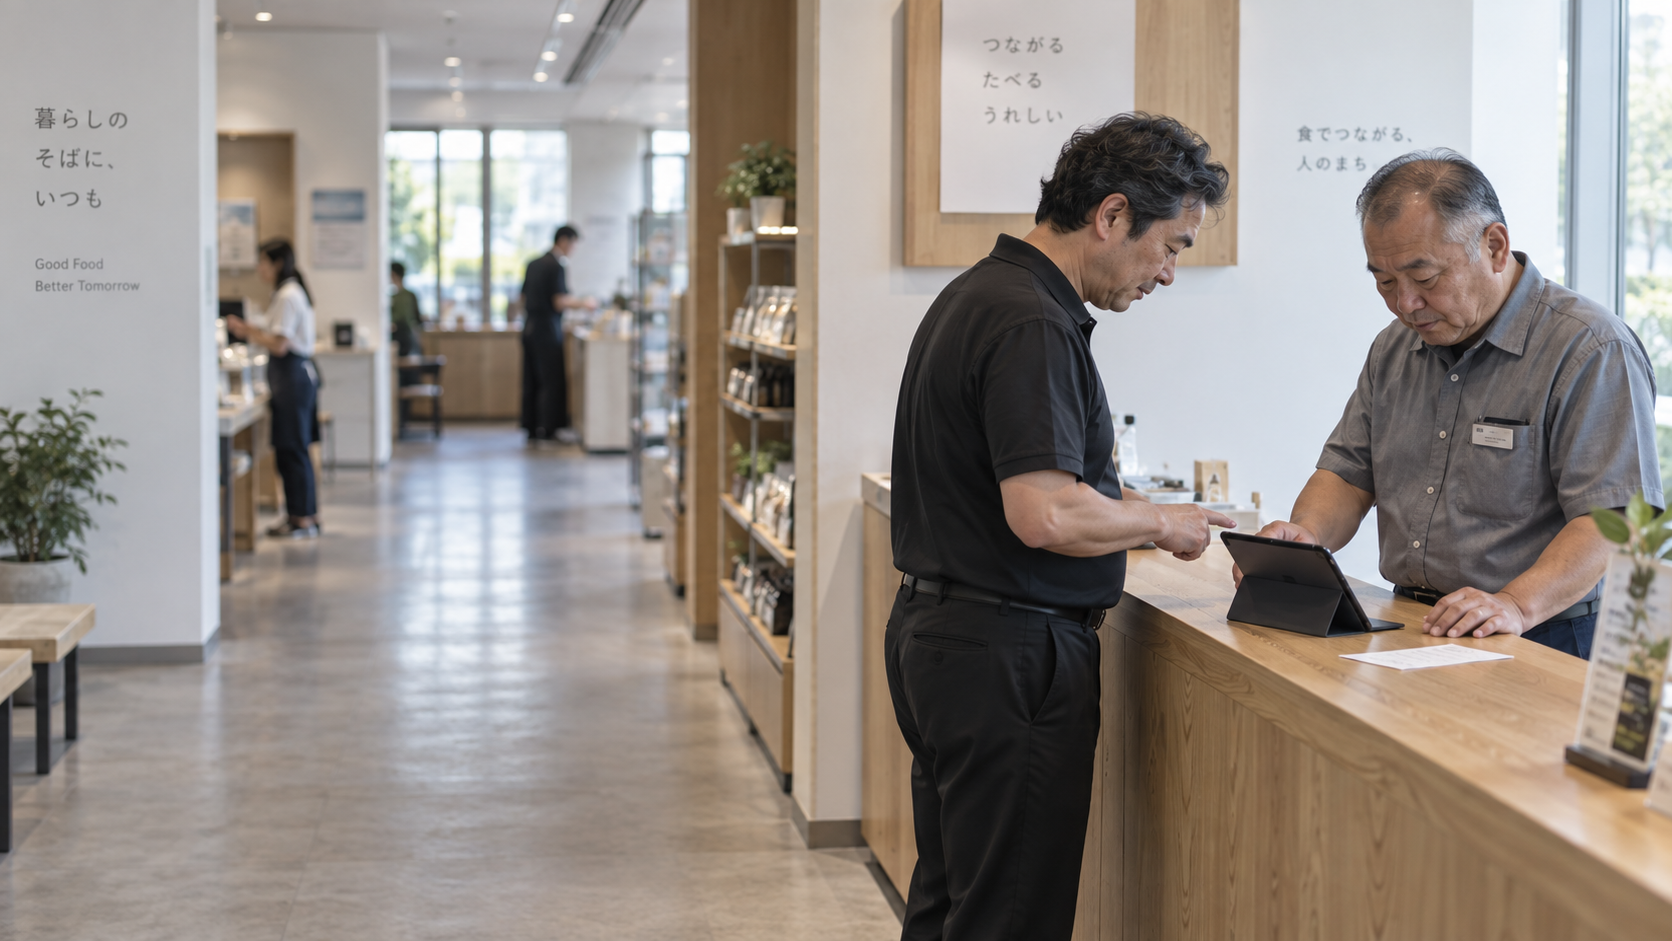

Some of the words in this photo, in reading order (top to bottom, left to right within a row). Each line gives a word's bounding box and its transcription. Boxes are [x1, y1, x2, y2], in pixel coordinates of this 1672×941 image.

[983, 36, 1064, 54] つながる
[983, 71, 1042, 89] たべる
[34, 107, 128, 129] 暮らしの
[984, 106, 1063, 125] うれしい
[1297, 125, 1412, 143] 食でつながる、
[35, 147, 114, 170] そばに、
[35, 188, 102, 209] いつも
[34, 257, 69, 271] Good
[72, 257, 104, 271] Food
[35, 279, 74, 292] Better
[77, 279, 141, 292] Tomorrow
